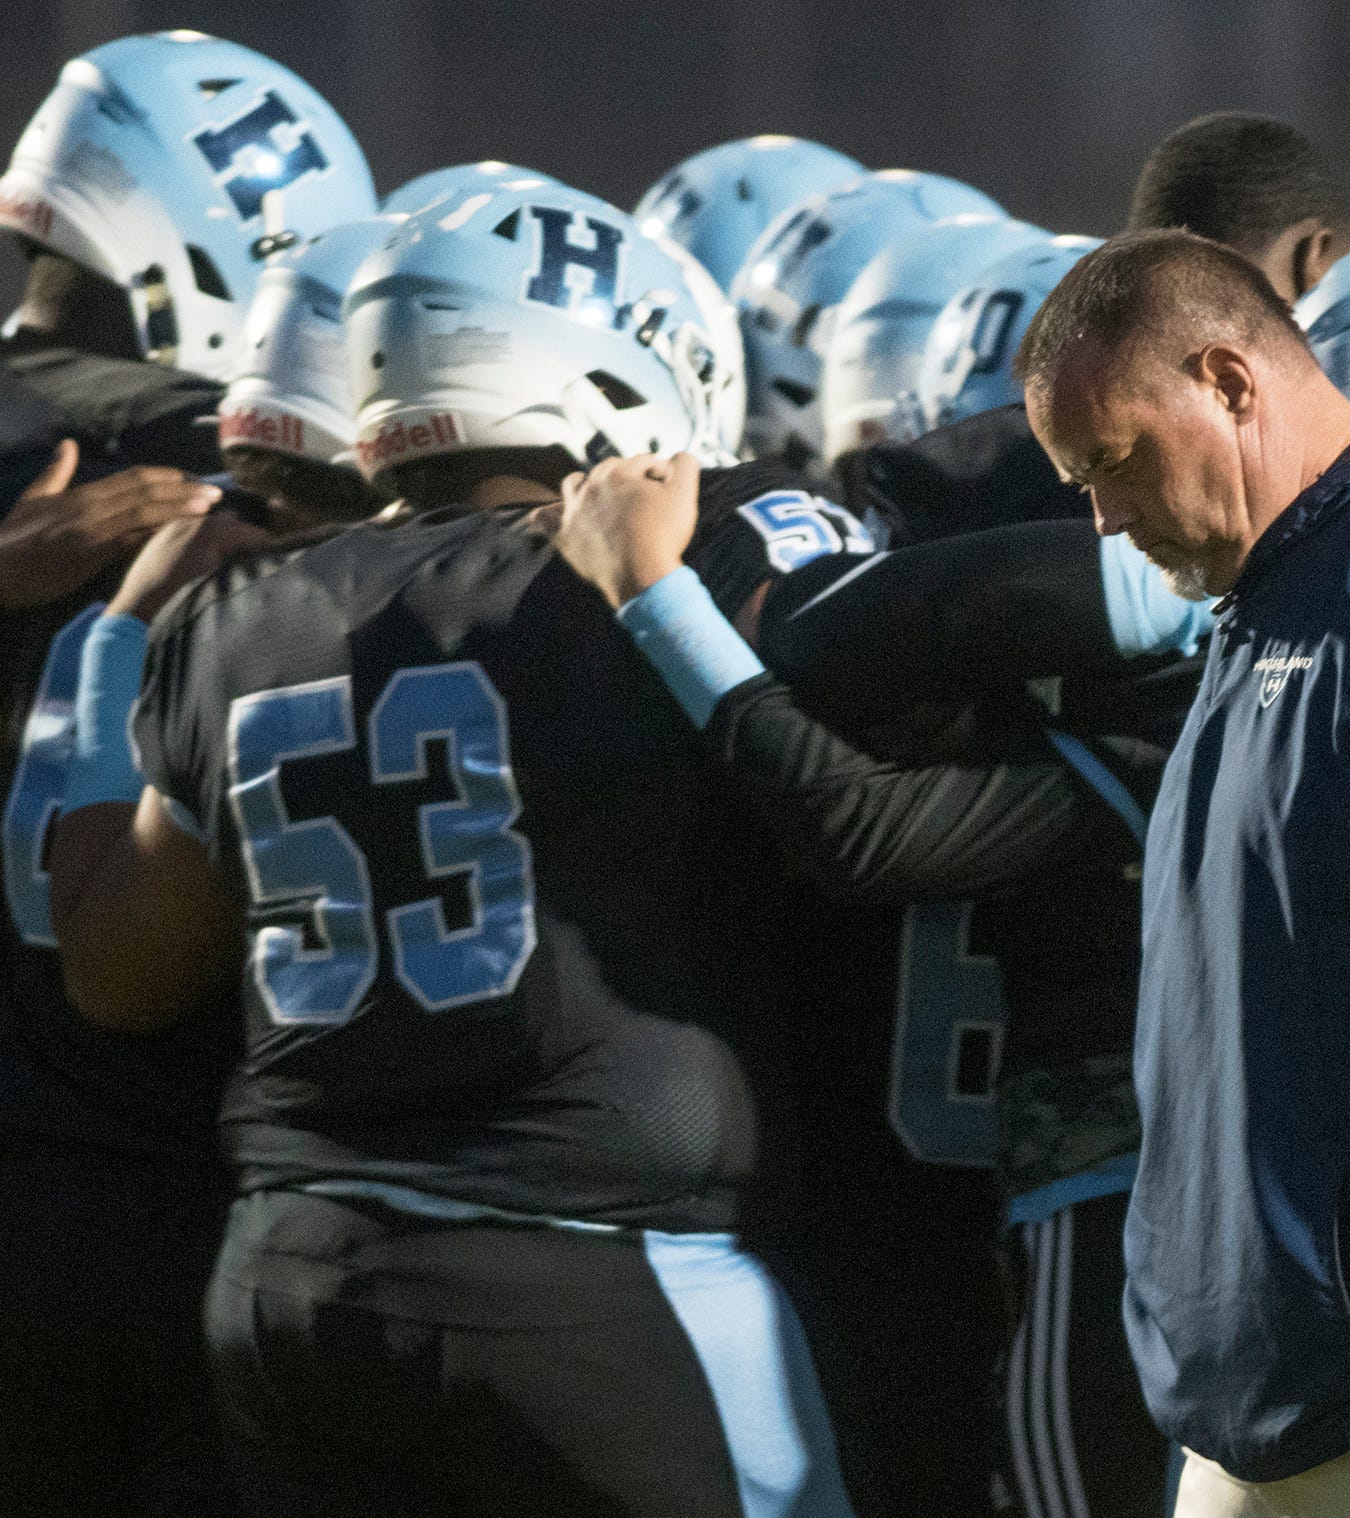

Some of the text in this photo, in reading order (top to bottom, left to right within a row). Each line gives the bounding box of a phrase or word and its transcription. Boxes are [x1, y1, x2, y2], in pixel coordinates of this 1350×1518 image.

[190, 86, 332, 222] H
[523, 204, 632, 328] H
[1253, 656, 1314, 671] HIGHLAND
[1266, 678, 1281, 693] H
[227, 660, 538, 1027] 53
